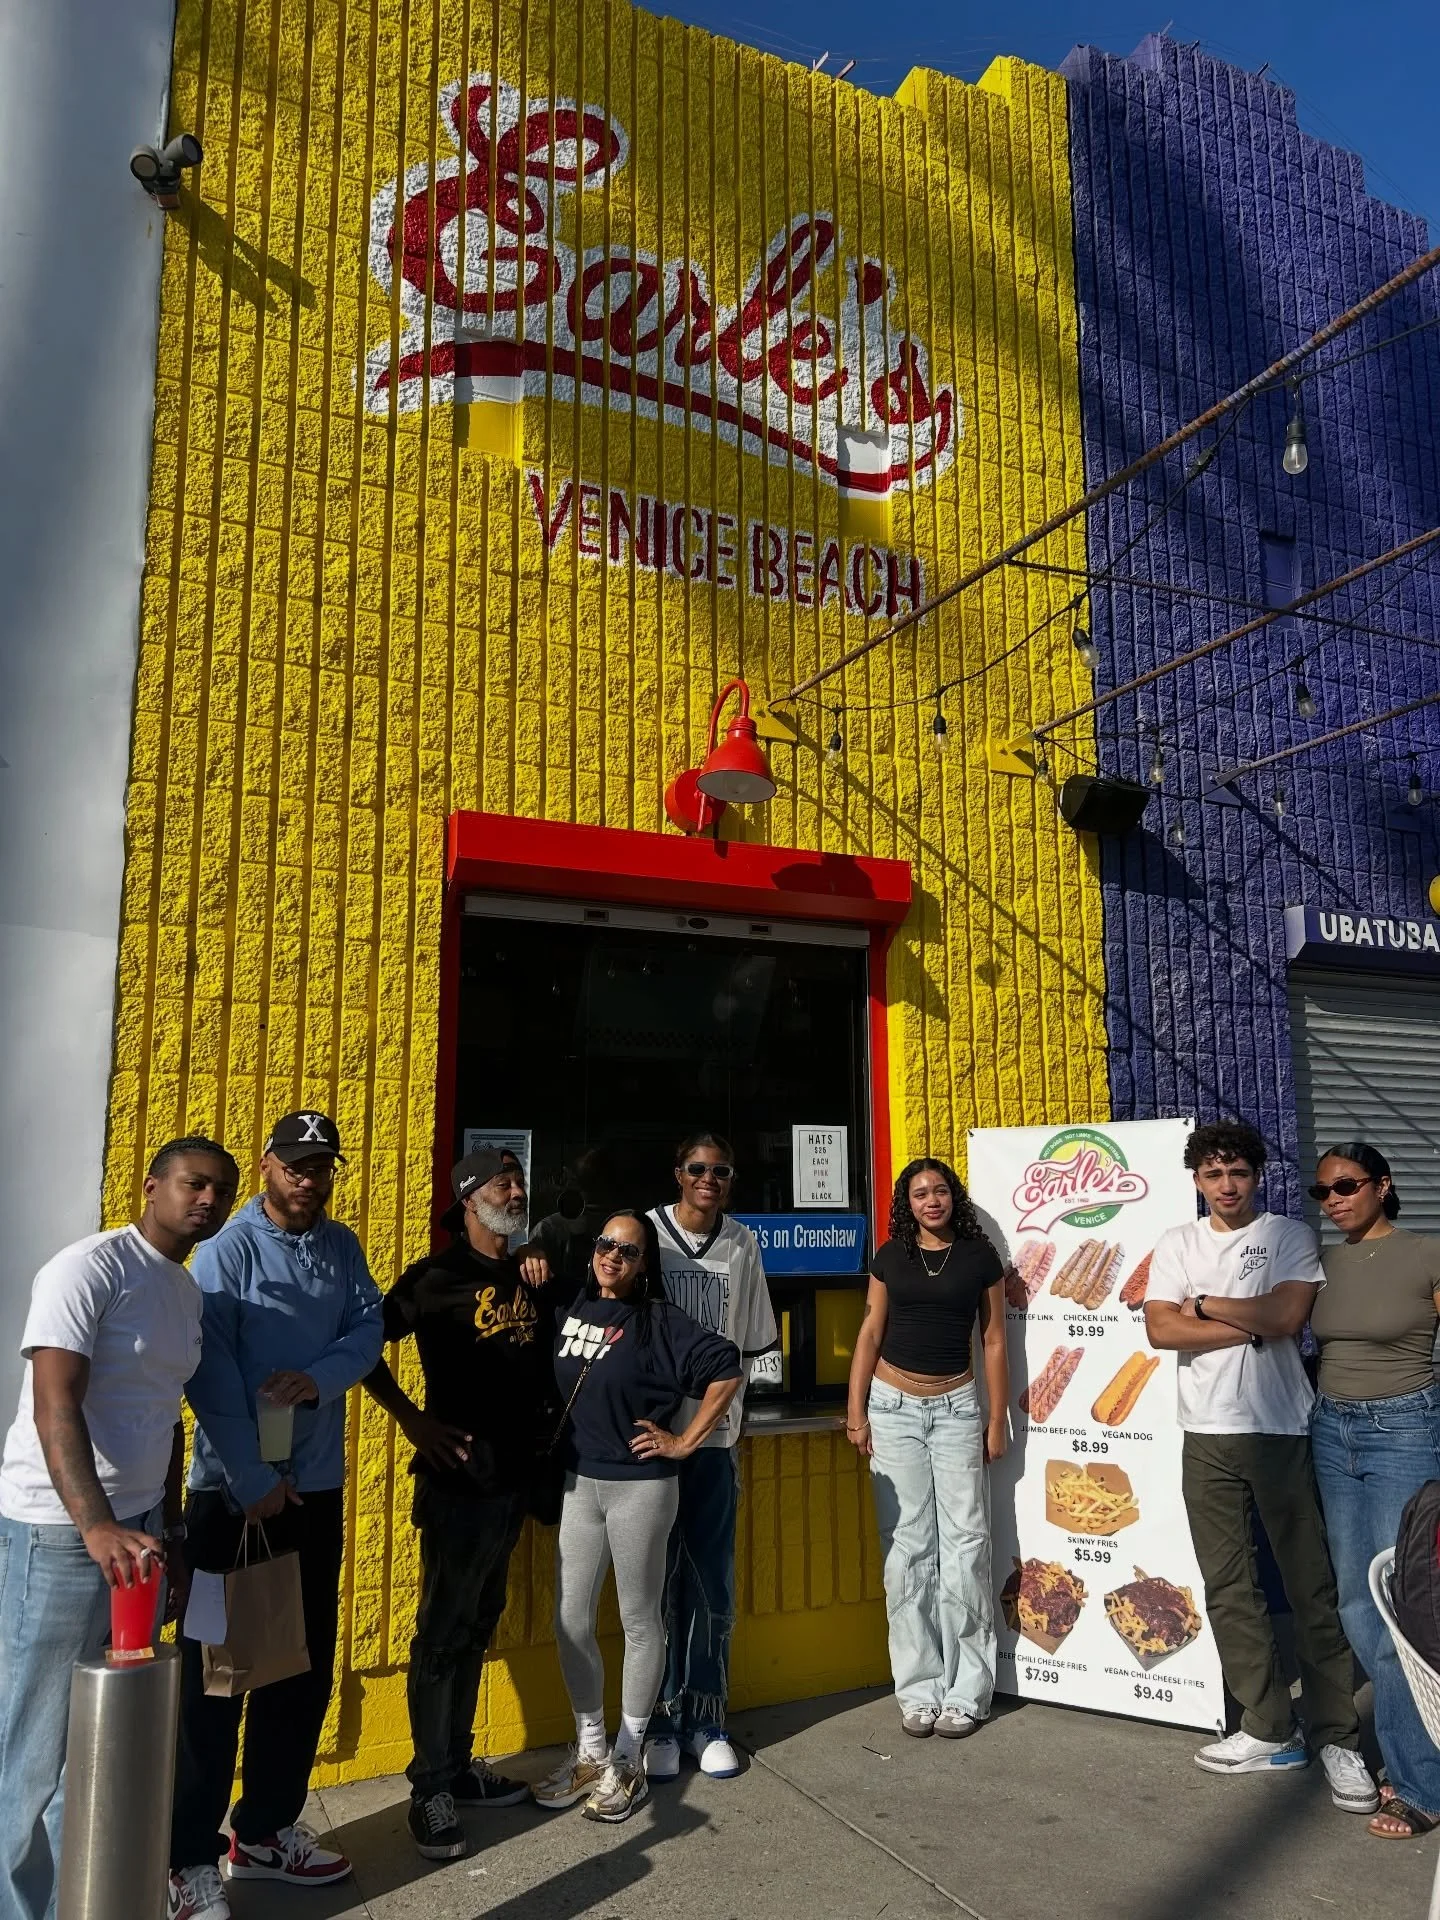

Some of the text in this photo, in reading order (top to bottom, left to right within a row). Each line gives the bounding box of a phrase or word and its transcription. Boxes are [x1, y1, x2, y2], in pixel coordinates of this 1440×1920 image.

[382, 84, 953, 460] Earle's
[527, 471, 922, 619] VENICE BEACH
[1319, 912, 1440, 953] UBATUBA
[297, 1114, 329, 1142] X
[808, 1134, 833, 1145] HATS
[813, 1169, 829, 1177] PINK
[1013, 1145, 1148, 1222] Earle's
[811, 1192, 832, 1200] BLACK
[1074, 1213, 1107, 1225] VENICE
[773, 1229, 790, 1249] on
[793, 1224, 857, 1249] Crenshaw
[474, 1284, 538, 1334] Earle's
[1063, 1314, 1098, 1322] CHICKEN
[1068, 1323, 1105, 1337] $9.99
[1020, 1425, 1087, 1436] JUMBO BEEF DOG
[1102, 1430, 1153, 1441] VEGAN DOG
[1072, 1439, 1109, 1454] $8.99
[1067, 1536, 1118, 1548] SKINNY FRIES
[1074, 1548, 1112, 1563] $5.99
[999, 1651, 1088, 1672] BEEF CHILI CHEESE FRIES
[1025, 1666, 1060, 1684] $7.99
[1104, 1666, 1205, 1688] VEGAN CHILI CHEESE FRIES
[1134, 1684, 1174, 1702] $9.49
